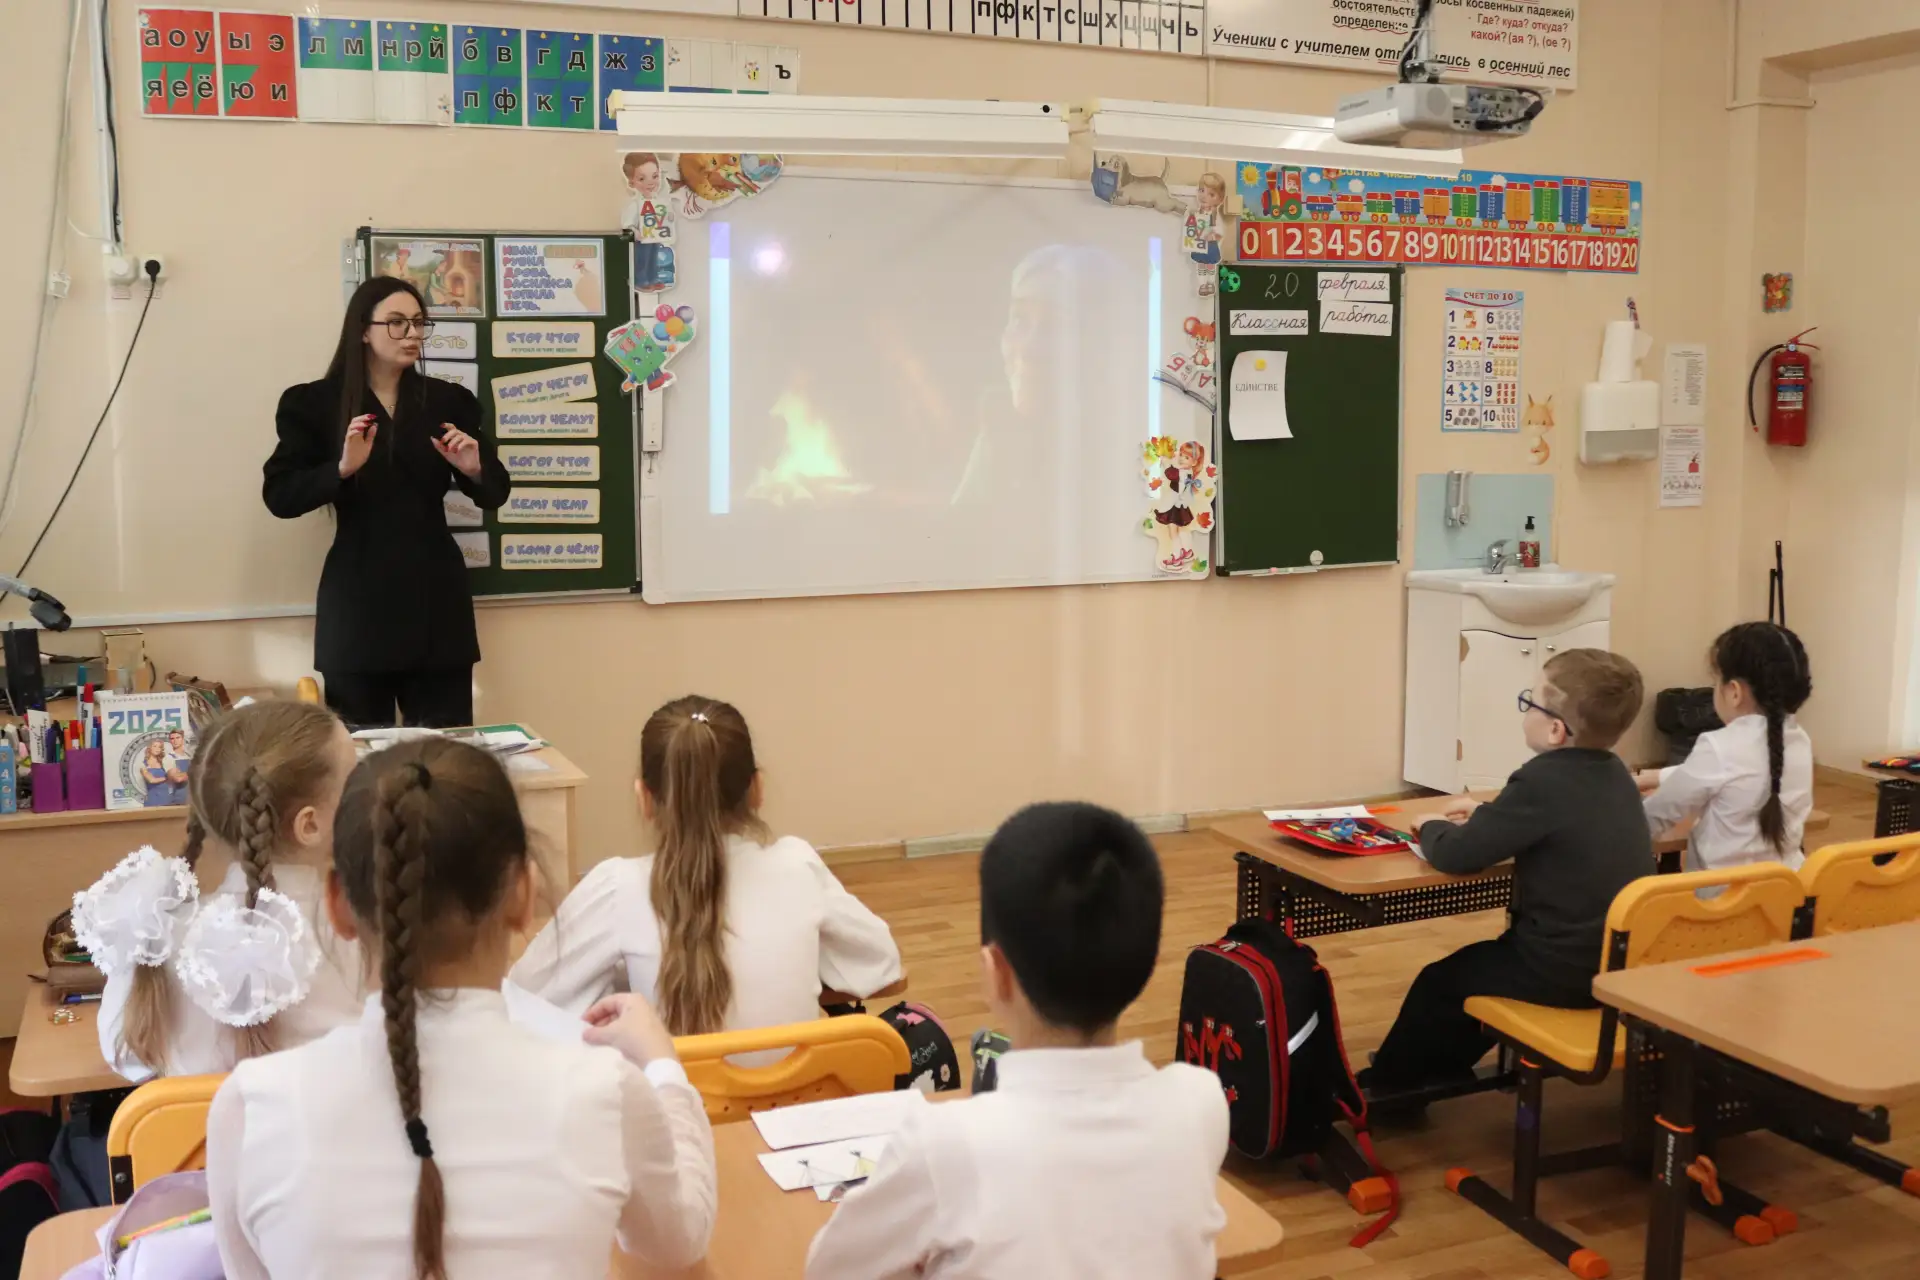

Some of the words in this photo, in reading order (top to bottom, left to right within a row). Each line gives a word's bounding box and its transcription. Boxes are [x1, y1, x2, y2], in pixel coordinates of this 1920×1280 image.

[1477, 13, 1499, 25] Где?
[1502, 18, 1529, 29] куда?
[1531, 22, 1568, 33] откуда?
[1281, 38, 1289, 49] с
[1294, 40, 1370, 57] учителем
[1478, 58, 1486, 69] в
[1489, 59, 1544, 75] осенний
[1547, 65, 1571, 78] лес
[1242, 228, 1260, 255] 0
[1266, 228, 1278, 255] 1
[1285, 228, 1303, 255] 2
[1308, 228, 1324, 255] 3
[1328, 229, 1344, 256] 4
[1348, 229, 1363, 256] 5
[1367, 229, 1383, 257] 6
[1385, 231, 1401, 257] 7
[1404, 231, 1419, 258] 8
[1423, 232, 1438, 259] 9
[1441, 233, 1457, 260] 10
[1459, 234, 1475, 261] 11
[1476, 235, 1493, 262] 12
[1494, 236, 1512, 263] 13
[1512, 236, 1530, 263] 14
[1532, 238, 1549, 264] 15
[1551, 239, 1568, 265] 16
[1569, 240, 1586, 266] 17
[1587, 241, 1603, 266] 18
[1604, 242, 1621, 267] 19
[1621, 242, 1637, 268] 20
[1264, 272, 1299, 299] 20
[1487, 292, 1500, 301] ДО
[1502, 293, 1514, 301] 10
[1231, 312, 1308, 329] Классная
[1449, 310, 1455, 322] 1
[1486, 312, 1494, 324] 6
[1448, 335, 1456, 348] 2
[1486, 337, 1494, 349] 7
[1446, 360, 1454, 372] 3
[1485, 361, 1493, 373] 8
[1446, 384, 1454, 396] 4
[1484, 385, 1492, 397] 9
[1445, 410, 1453, 421] 5
[1483, 410, 1496, 422] 10
[108, 708, 182, 735] 2025
